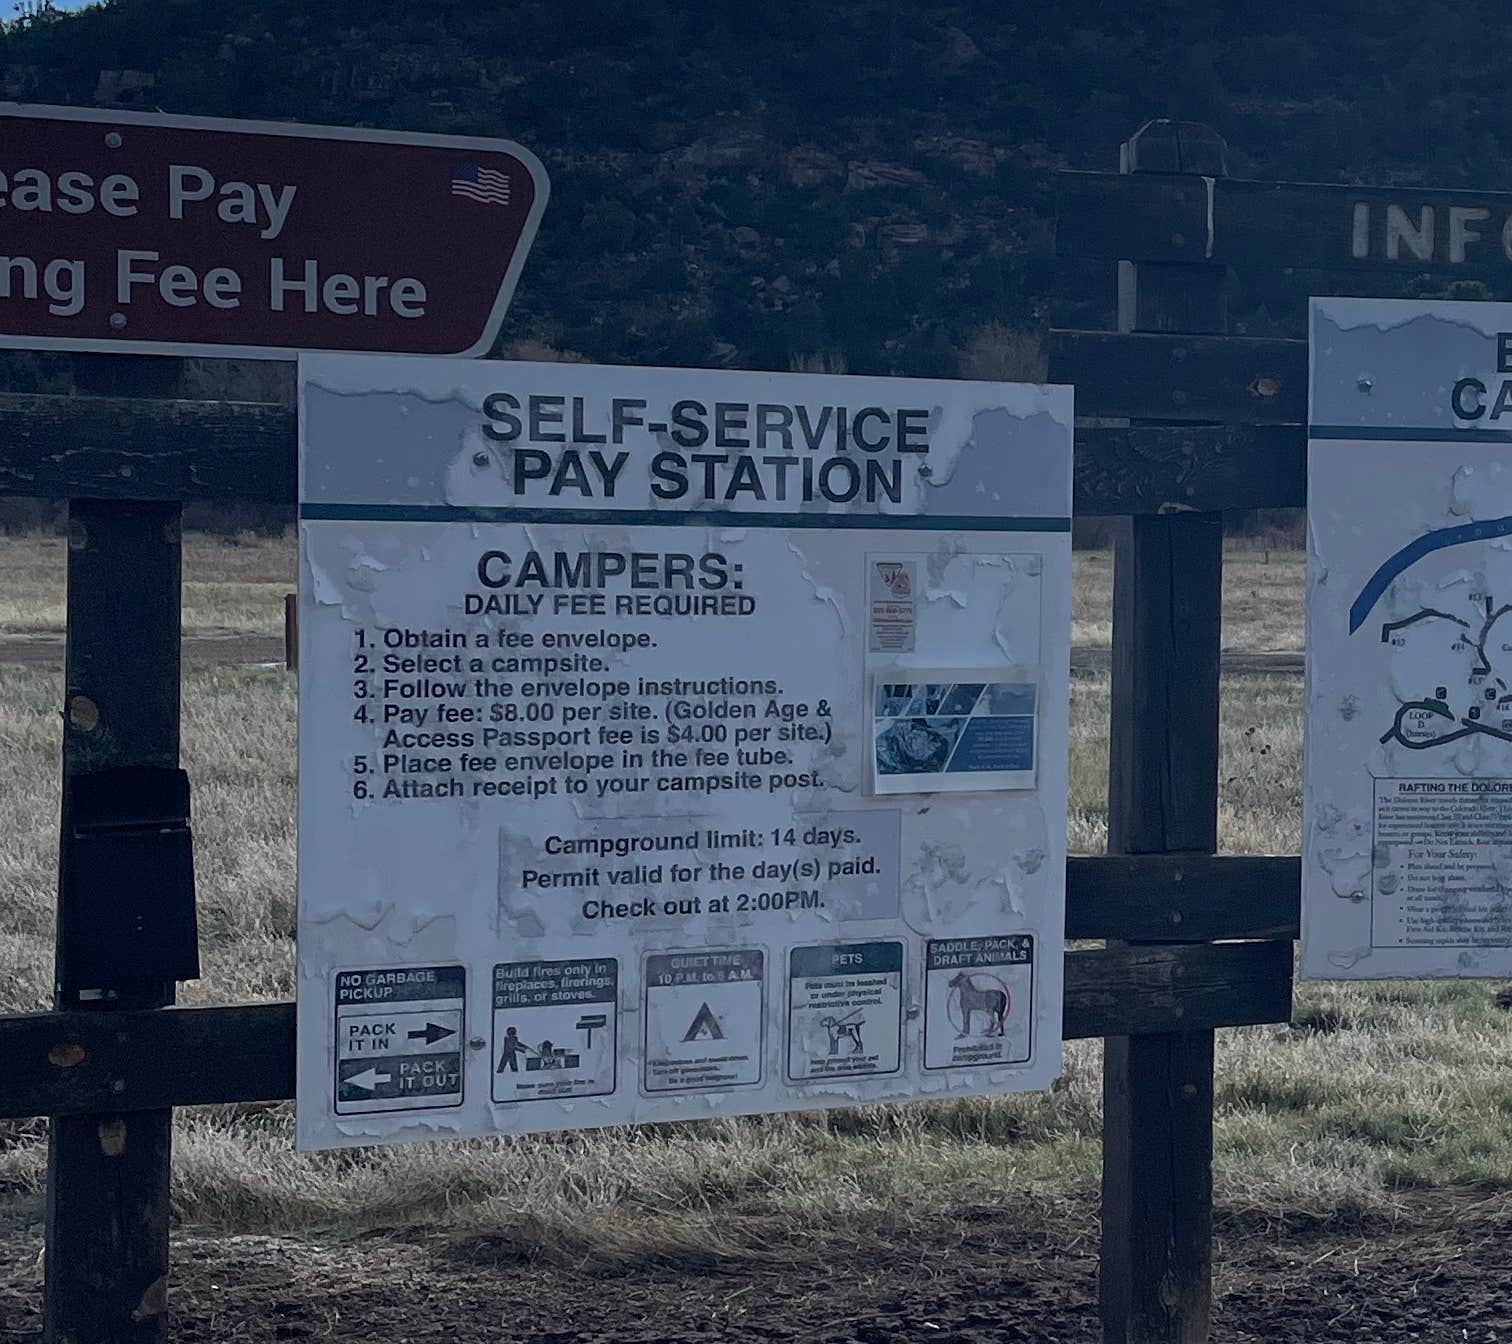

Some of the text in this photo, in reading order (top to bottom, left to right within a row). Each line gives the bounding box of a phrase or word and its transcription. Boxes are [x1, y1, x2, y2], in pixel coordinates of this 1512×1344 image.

[169, 165, 296, 239] Pay
[117, 249, 241, 309] Fee
[270, 257, 426, 318] Here
[482, 393, 929, 453] SELF-SERVICE
[513, 449, 903, 503] PAY STATION
[477, 550, 743, 590] CAMPERS:
[465, 594, 755, 617] DAILY FEE REQUIRED
[355, 629, 657, 655] 1. Obtain a fee envelope.
[354, 653, 609, 676] 2. Select a campsite.
[354, 678, 783, 702] 3. Follow the envelope instructions.
[354, 700, 831, 728] 4. Pay fee: $8.00 per site. (Golden Age &
[384, 723, 831, 752] Access Passport fee is $4.00 per site.)
[354, 748, 793, 775] 5. Place fee envelope in the fee tube.
[354, 770, 824, 801] 6. Attach receipt to your campsite post.
[1399, 783, 1446, 792] RAFTING
[1448, 784, 1469, 792] THE
[544, 828, 861, 858] Campground limit: 14 days.
[522, 857, 880, 888] Permit valid for the day(s) paid.
[582, 891, 824, 919] Check out at 2:00PM.
[985, 939, 1018, 950] PACK,
[1022, 939, 1030, 947] &
[832, 954, 863, 964] PETS
[934, 954, 972, 965] DRAFT
[341, 971, 434, 987] NO GARBAGE
[496, 964, 606, 979] Build fires only in
[659, 975, 672, 984] 10
[728, 969, 753, 980] A.M.
[341, 988, 393, 1000] PICKUP
[496, 980, 559, 991] fireplaces,
[496, 991, 595, 1005] grills, or stoves.
[349, 1023, 396, 1036] PACK
[349, 1038, 388, 1051] IT IN
[400, 1061, 446, 1073] PACK
[400, 1074, 458, 1089] IT OUT
